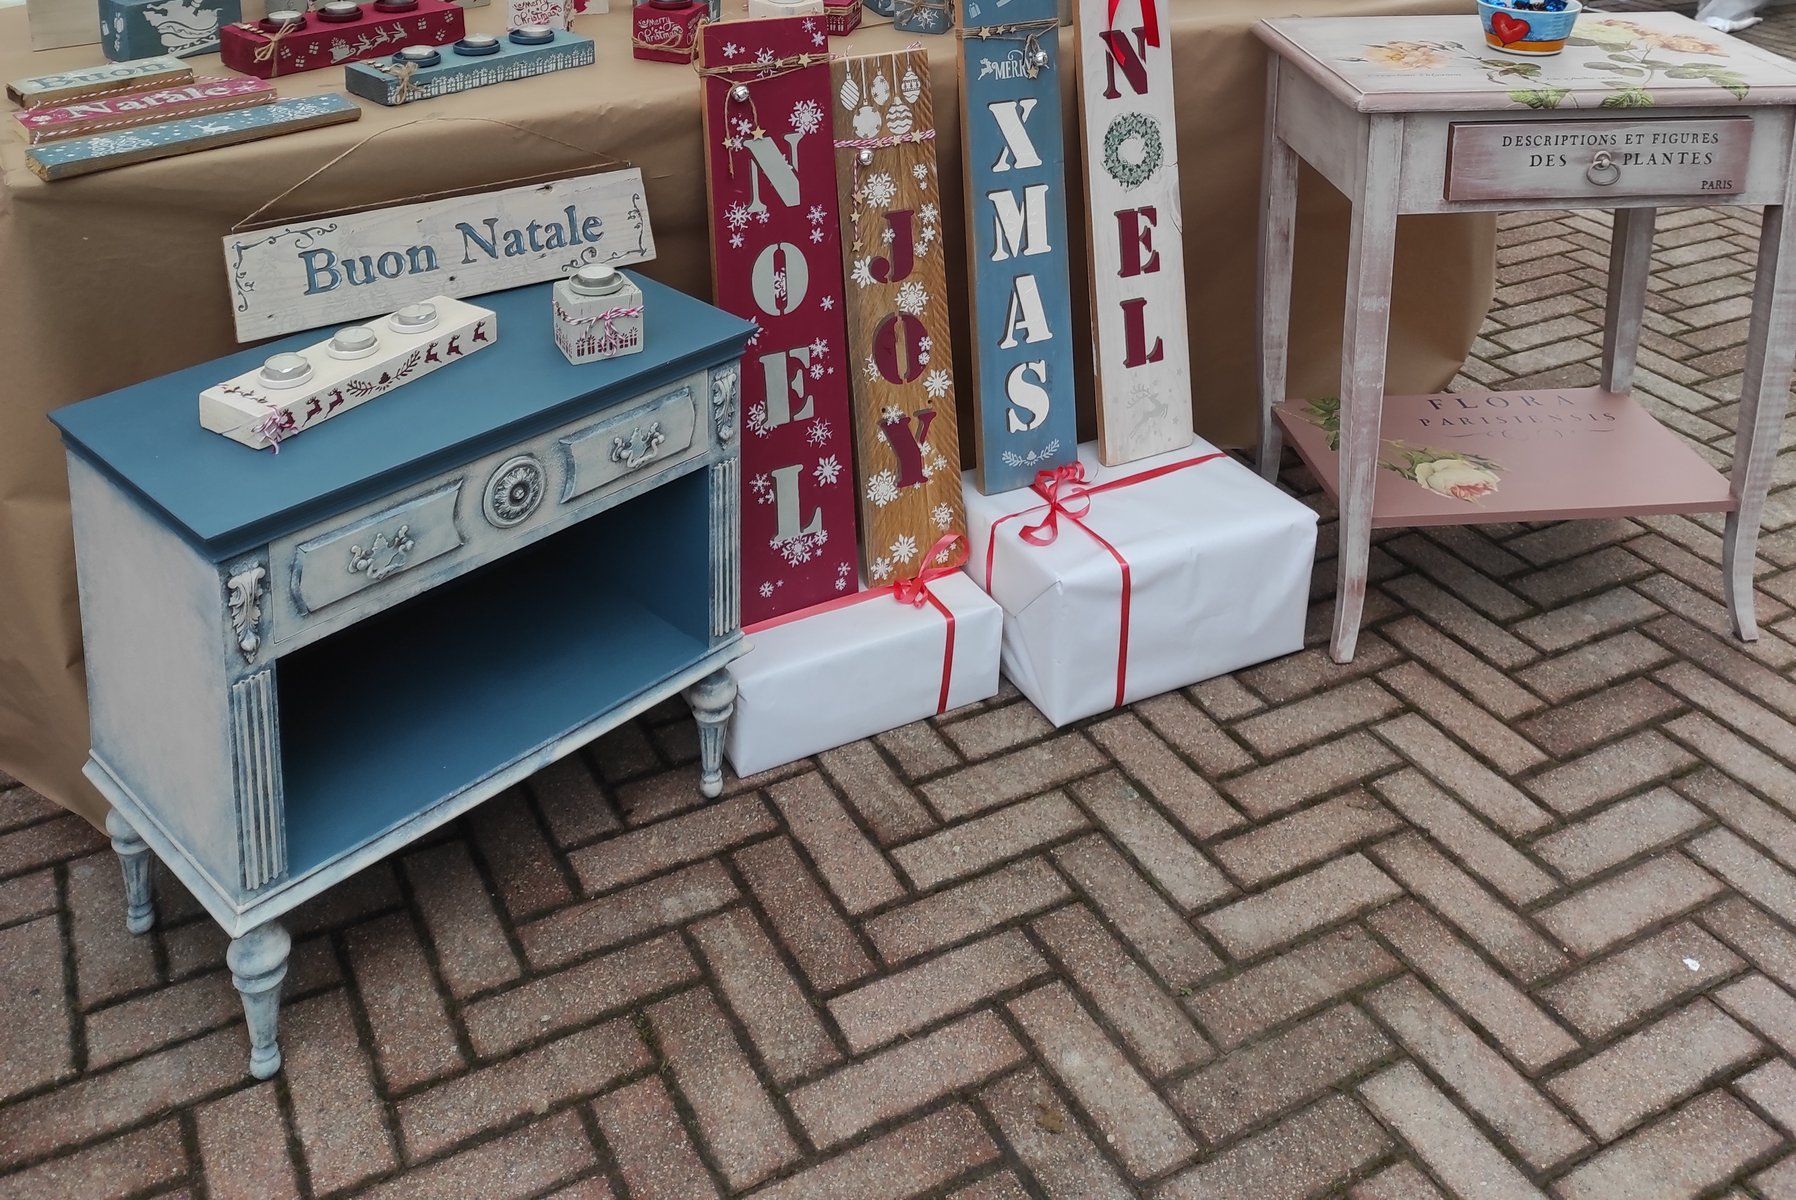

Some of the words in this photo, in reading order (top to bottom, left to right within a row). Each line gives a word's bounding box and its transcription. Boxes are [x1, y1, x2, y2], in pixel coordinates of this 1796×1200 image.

[638, 17, 675, 32] Merry
[27, 62, 169, 91] Buon
[63, 86, 233, 121] Natale
[1502, 133, 1618, 148] DESCRIPTIONS
[1624, 133, 1645, 146] ET
[1651, 132, 1720, 145] FIGURES
[1529, 153, 1568, 168] DES
[1622, 151, 1713, 167] PLANTES
[1700, 179, 1733, 191] PARIS
[298, 244, 440, 297] Buon
[455, 204, 604, 265] Natale
[988, 98, 1053, 434] XMAS
[743, 132, 823, 542] NOEL
[868, 208, 938, 490] JOY
[1427, 394, 1575, 411] FLORA
[1418, 412, 1617, 428] PARISIENSIS
